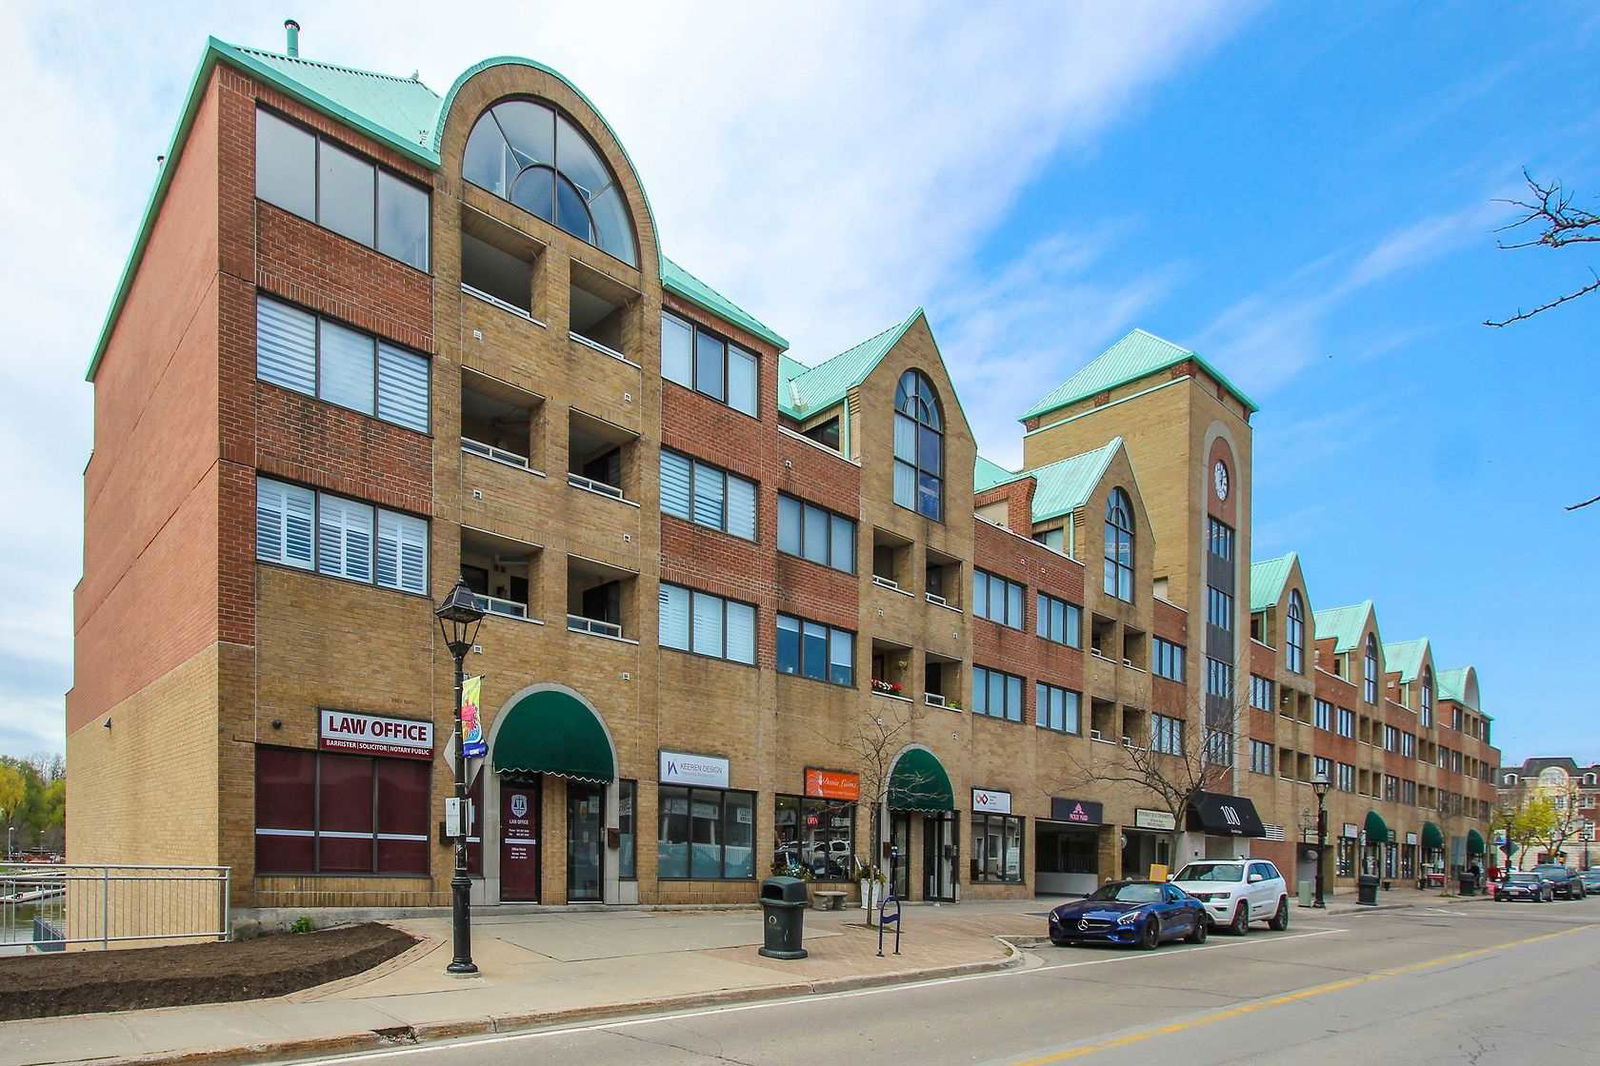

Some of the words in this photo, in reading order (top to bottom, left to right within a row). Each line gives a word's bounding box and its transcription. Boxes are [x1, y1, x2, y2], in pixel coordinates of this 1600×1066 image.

[329, 715, 367, 735] LAW
[371, 720, 427, 742] OFFICE
[326, 739, 356, 749] BARRISTER
[359, 742, 388, 752] SOLICITOR
[389, 745, 411, 754] NOTARY
[411, 747, 430, 756] PUBLIC
[1220, 805, 1240, 826] 100
